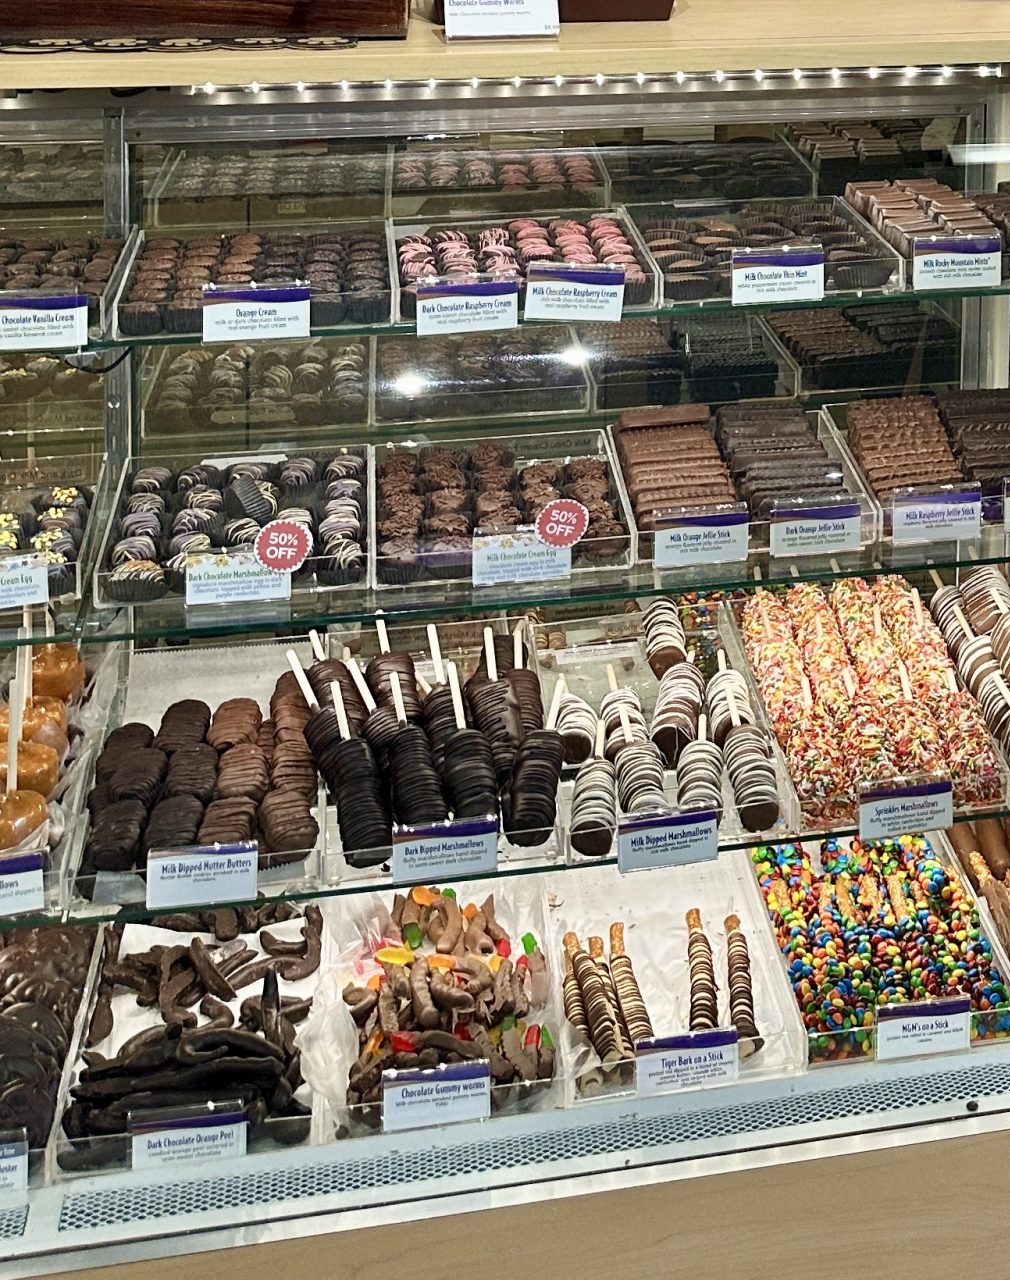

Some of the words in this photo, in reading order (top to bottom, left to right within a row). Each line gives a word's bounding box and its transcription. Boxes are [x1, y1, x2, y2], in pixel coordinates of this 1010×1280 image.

[449, 0, 478, 8] Chocolate
[745, 273, 756, 281] Milk
[757, 271, 782, 280] Chocolate
[533, 287, 544, 296] Milk
[546, 287, 572, 296] Chocolate
[574, 289, 600, 299] Raspberry
[601, 290, 618, 298] Cream
[422, 304, 435, 313] Dark
[437, 303, 464, 312] Chocolate
[465, 301, 494, 311] Raspberry
[495, 299, 512, 308] Cream
[2, 315, 31, 325] Chocolate
[33, 314, 54, 323] Vanilla
[55, 313, 74, 322] Cream
[236, 309, 257, 318] Orange
[259, 308, 277, 316] Cream
[551, 509, 577, 524] 50%
[906, 511, 918, 520] Milk
[919, 509, 945, 520] Raspberry
[545, 522, 574, 537] OFF
[786, 525, 797, 534] Dark
[799, 524, 817, 533] Orange
[269, 532, 299, 546] 50%
[670, 534, 681, 542] Milk
[683, 532, 701, 541] Orange
[266, 546, 298, 560] OFF
[487, 553, 499, 561] Milk
[500, 551, 527, 560] Chocolate
[529, 550, 545, 559] Cream
[189, 572, 202, 582] Dark
[203, 571, 232, 581] Chocolate
[875, 805, 900, 818] Sprinkles
[631, 837, 644, 847] Milk
[646, 833, 667, 845] Dipped
[668, 827, 712, 840] Marshmallows
[405, 846, 418, 855] Dark
[420, 844, 441, 854] Dipped
[442, 840, 484, 851] Marshmallows
[162, 863, 176, 874] Milk
[179, 862, 202, 873] Dipped
[204, 861, 225, 871] Nutter
[227, 858, 252, 869] Butters
[935, 1019, 949, 1029] Stick
[662, 1058, 677, 1069] Tiger
[678, 1055, 692, 1066] Bark
[708, 1051, 723, 1061] Stick
[401, 1087, 434, 1098] Chocolate
[435, 1083, 461, 1095] Gummy
[463, 1081, 486, 1090] worms
[147, 1140, 163, 1149] Dark
[164, 1136, 195, 1147] Chocolate
[196, 1133, 219, 1144] Orange
[220, 1131, 234, 1140] Peel
